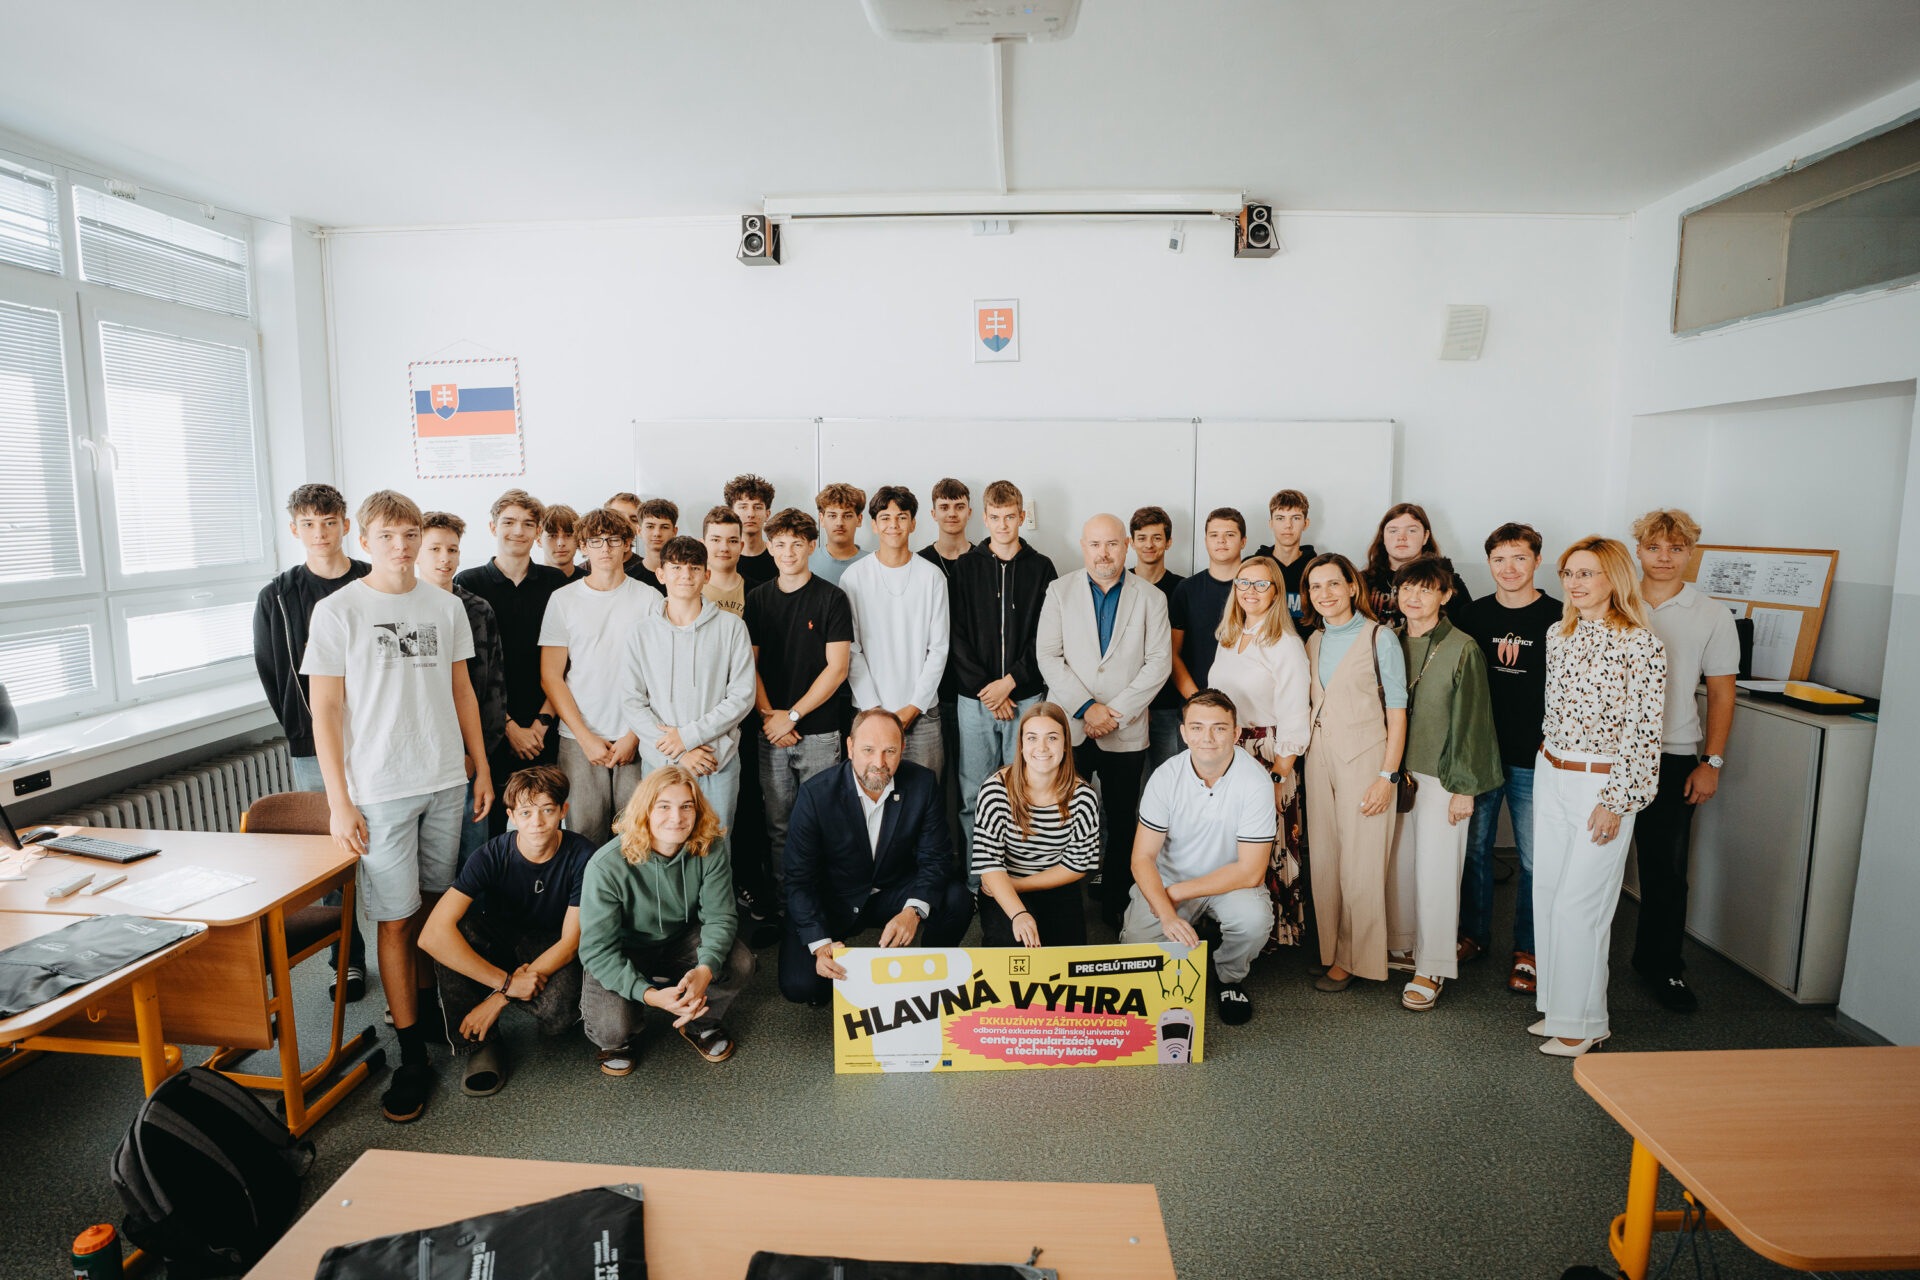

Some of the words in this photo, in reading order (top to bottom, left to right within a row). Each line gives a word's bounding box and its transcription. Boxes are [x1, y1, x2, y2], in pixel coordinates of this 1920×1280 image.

[1075, 963, 1094, 974] PRE
[1095, 960, 1121, 972] CELÚ
[1121, 959, 1157, 970] TRIEDU
[1220, 990, 1249, 1003] FILA
[843, 969, 1001, 1040] HLAVNÁ
[1009, 973, 1148, 1016] VÝHRA
[979, 1016, 1045, 1026] EXKLUZÍVNY
[1046, 1016, 1105, 1027] ZÁŽITKOVÝ
[1106, 1016, 1128, 1027] DEŇ
[973, 1026, 1007, 1034] odborná
[1008, 1027, 1041, 1035] exkurzia
[1054, 1026, 1086, 1037] Žilinskej
[1086, 1028, 1124, 1036] univerzite
[980, 1036, 1017, 1045] centre
[1018, 1036, 1095, 1048] popularizácie
[1095, 1036, 1125, 1048] vedy
[1005, 1047, 1013, 1055] a
[1014, 1046, 1065, 1059] techniky
[1065, 1046, 1098, 1056] Motio
